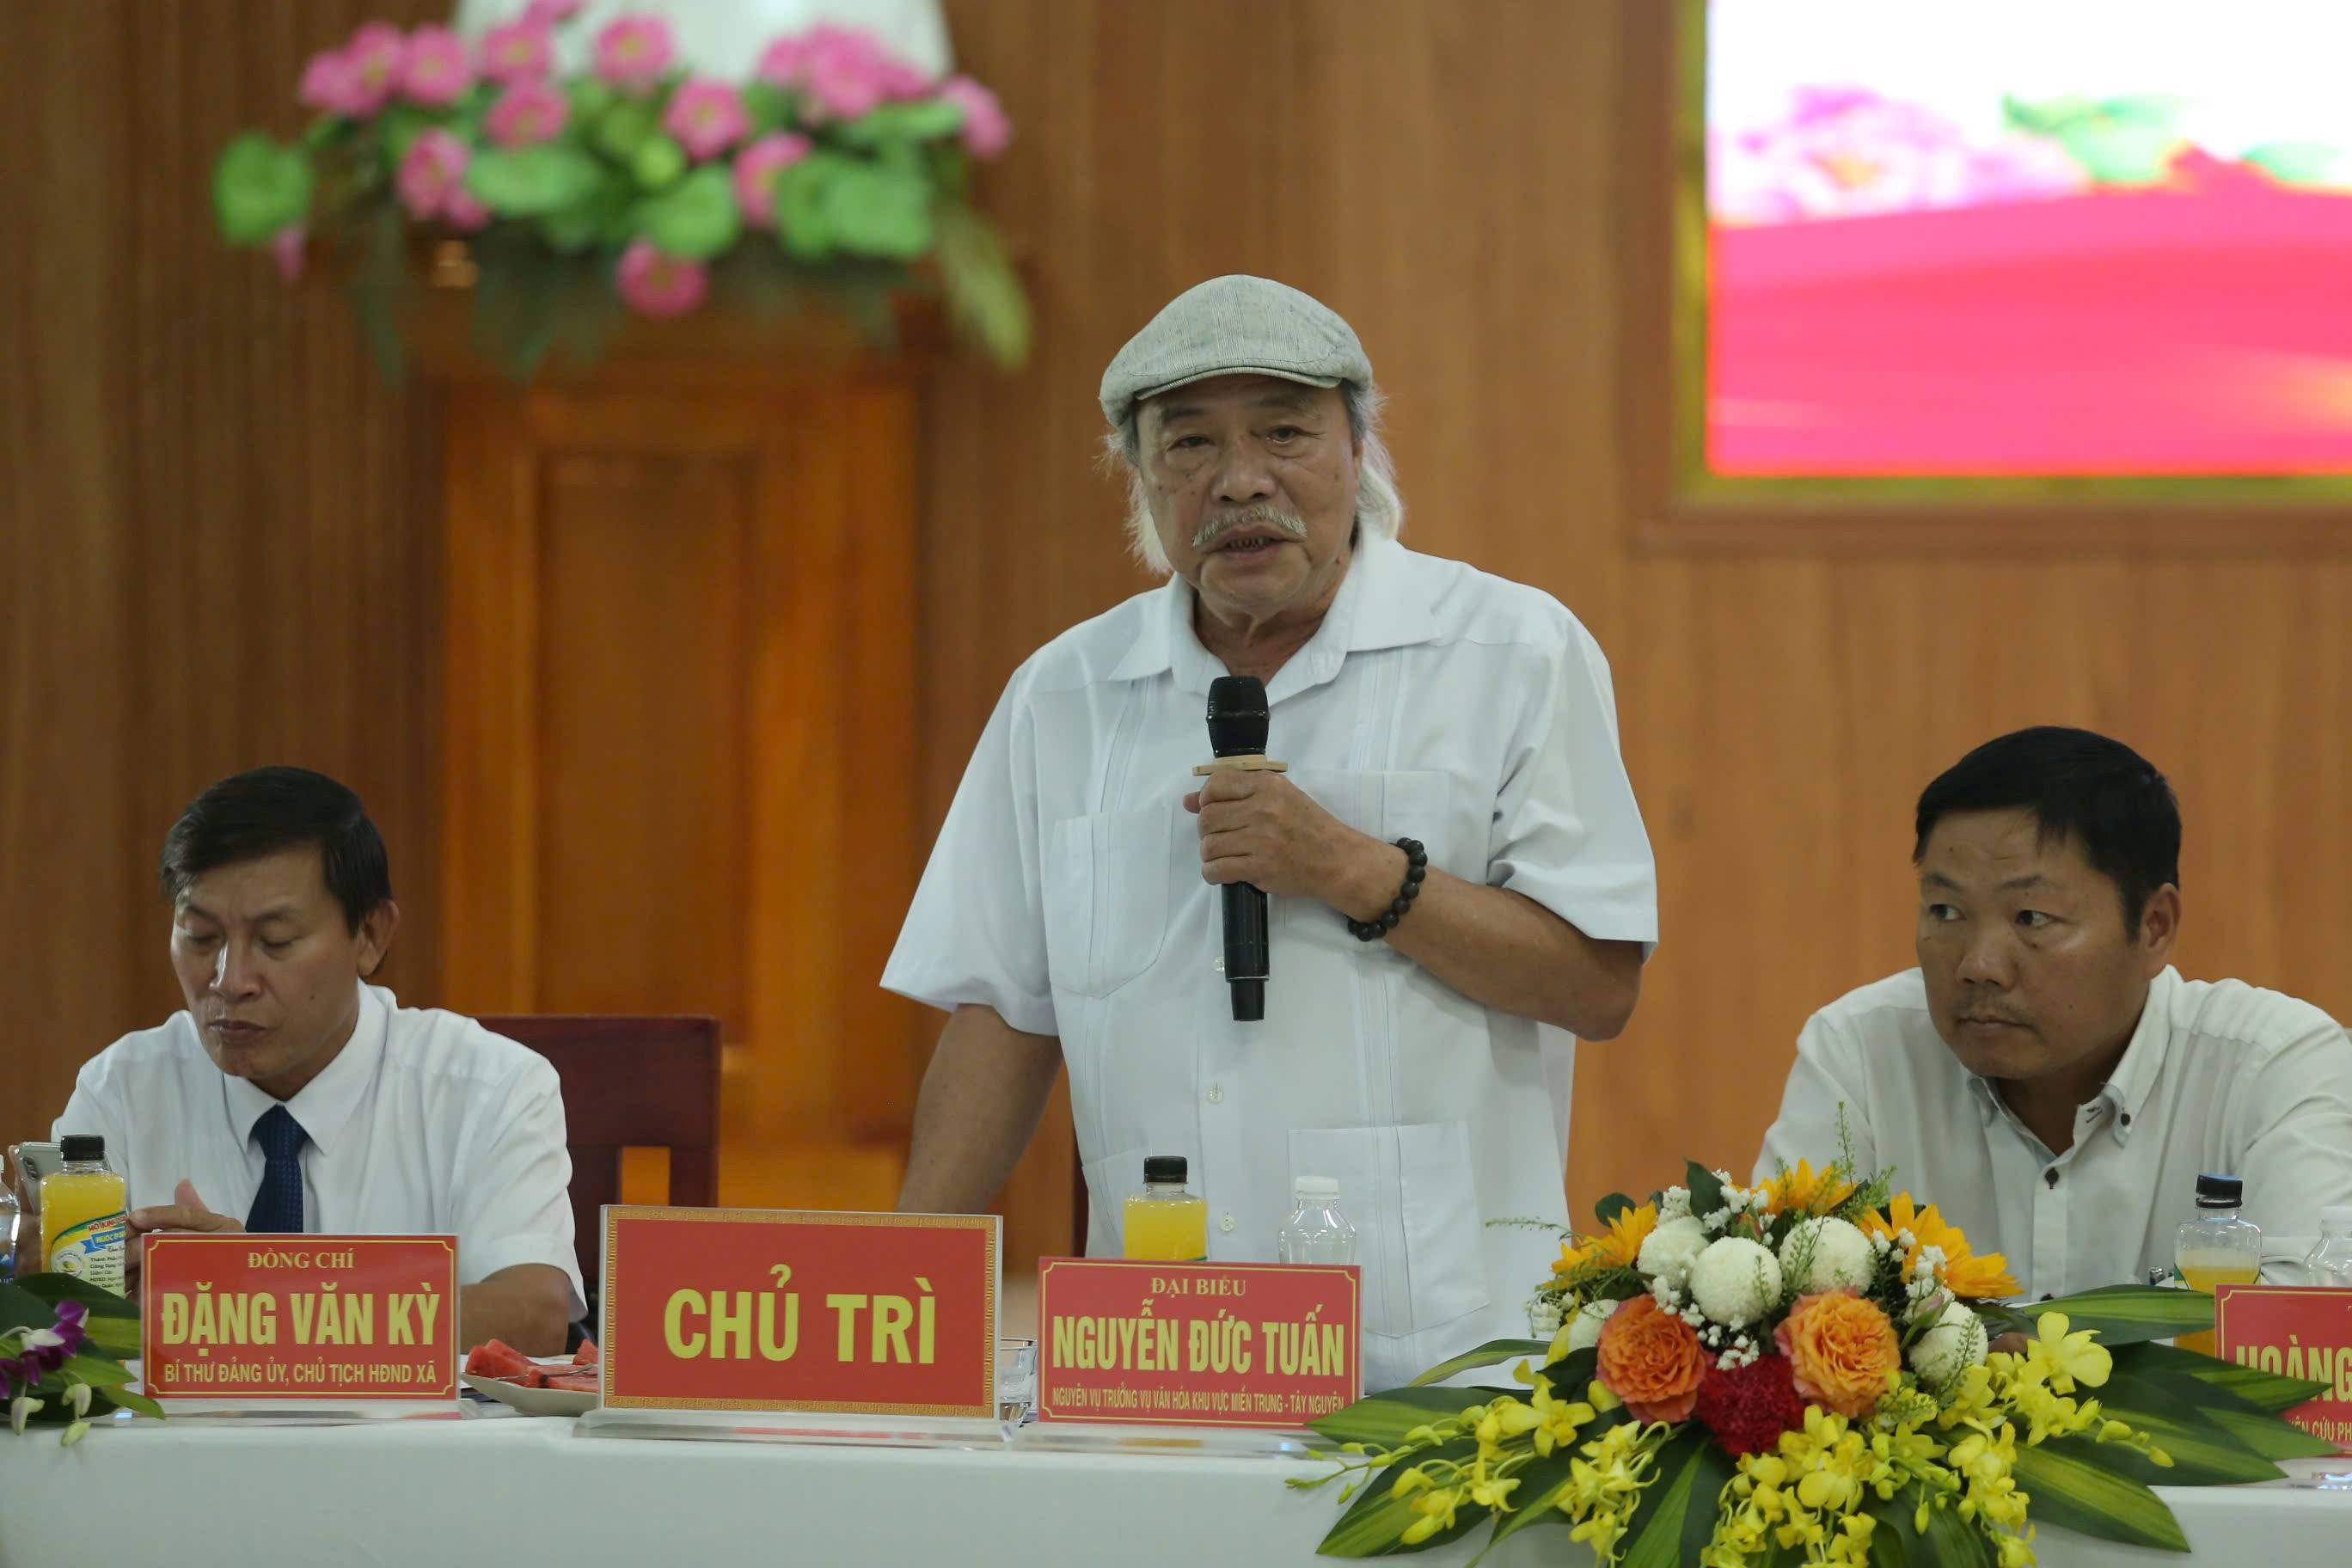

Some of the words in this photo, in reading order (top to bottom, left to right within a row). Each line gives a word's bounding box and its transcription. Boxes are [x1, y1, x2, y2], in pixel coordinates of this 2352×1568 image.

[315, 1247, 354, 1268] CHÍ
[1151, 1277, 1189, 1298] ĐẠI
[162, 1281, 277, 1357] ĐẶNG
[290, 1281, 374, 1344] VĂN
[388, 1282, 441, 1344] KỲ
[664, 1264, 799, 1362] CHỦ
[826, 1277, 936, 1364] TRÌ
[1052, 1298, 1179, 1371] NGUYỄN
[1188, 1308, 1253, 1375] ĐỨC
[1262, 1304, 1344, 1376] TUẤN
[164, 1358, 180, 1382] BÍ
[183, 1361, 215, 1382] THƯ
[218, 1356, 262, 1382] ĐẢNG
[266, 1356, 289, 1386] ỦY,
[293, 1356, 325, 1382] CHỦ
[329, 1363, 364, 1387] TỊCH
[369, 1364, 412, 1383] HĐND
[416, 1360, 437, 1383] XÃ
[1052, 1382, 1087, 1406] NGUYÊN
[1089, 1388, 1101, 1411] VỤ
[1103, 1381, 1138, 1408] TRƯỞNG
[1141, 1389, 1152, 1413] VỤ
[1154, 1386, 1170, 1409] VĂN
[1173, 1386, 1191, 1410] HÓA
[1192, 1391, 1210, 1411] KHU
[1211, 1389, 1229, 1416] VỰC
[1253, 1393, 1283, 1413] TRUNG
[1290, 1390, 1307, 1413] TÂY
